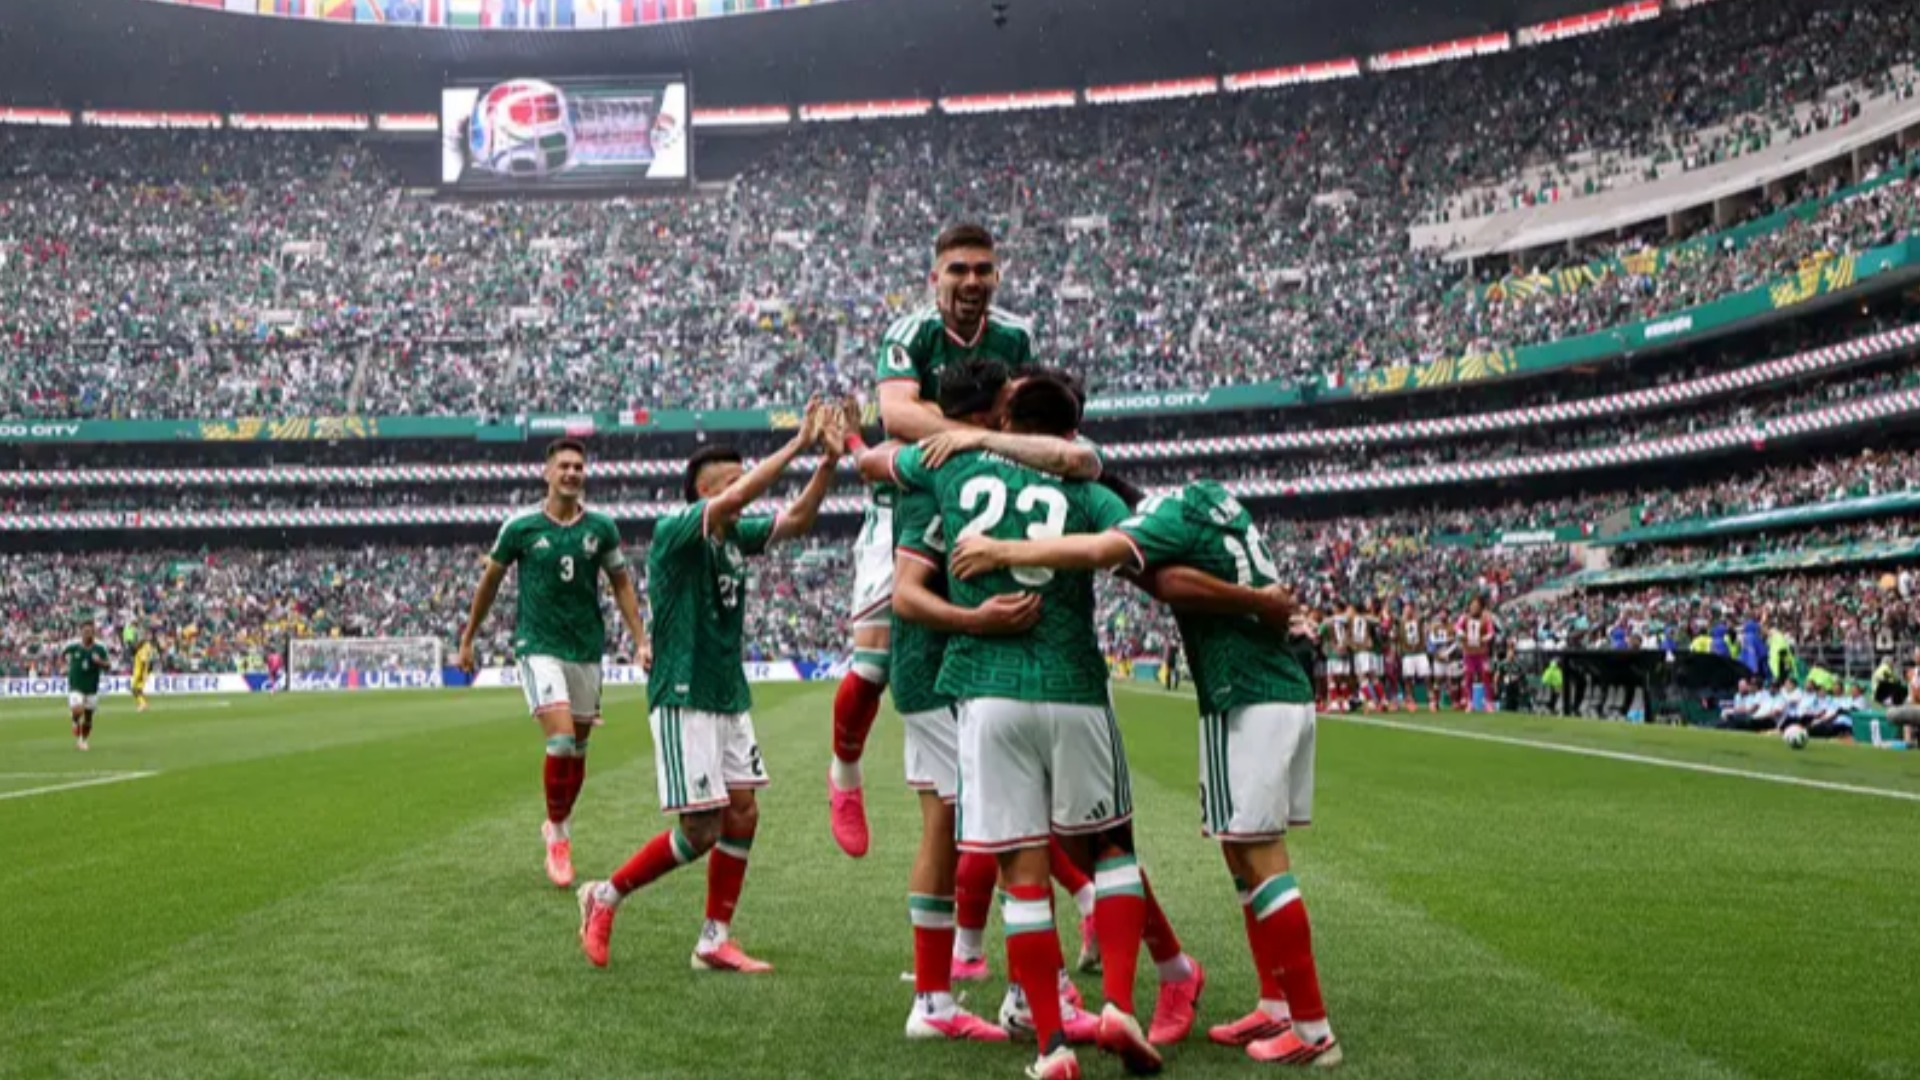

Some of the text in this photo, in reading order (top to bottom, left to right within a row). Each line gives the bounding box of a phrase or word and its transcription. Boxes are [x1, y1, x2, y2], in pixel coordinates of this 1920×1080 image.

[1084, 392, 1210, 410] MEXICO CITY
[31, 424, 79, 437] CITY
[955, 474, 1069, 586] 23
[560, 555, 574, 582] 3
[154, 676, 219, 692] BEER
[365, 669, 442, 688] ULTRA
